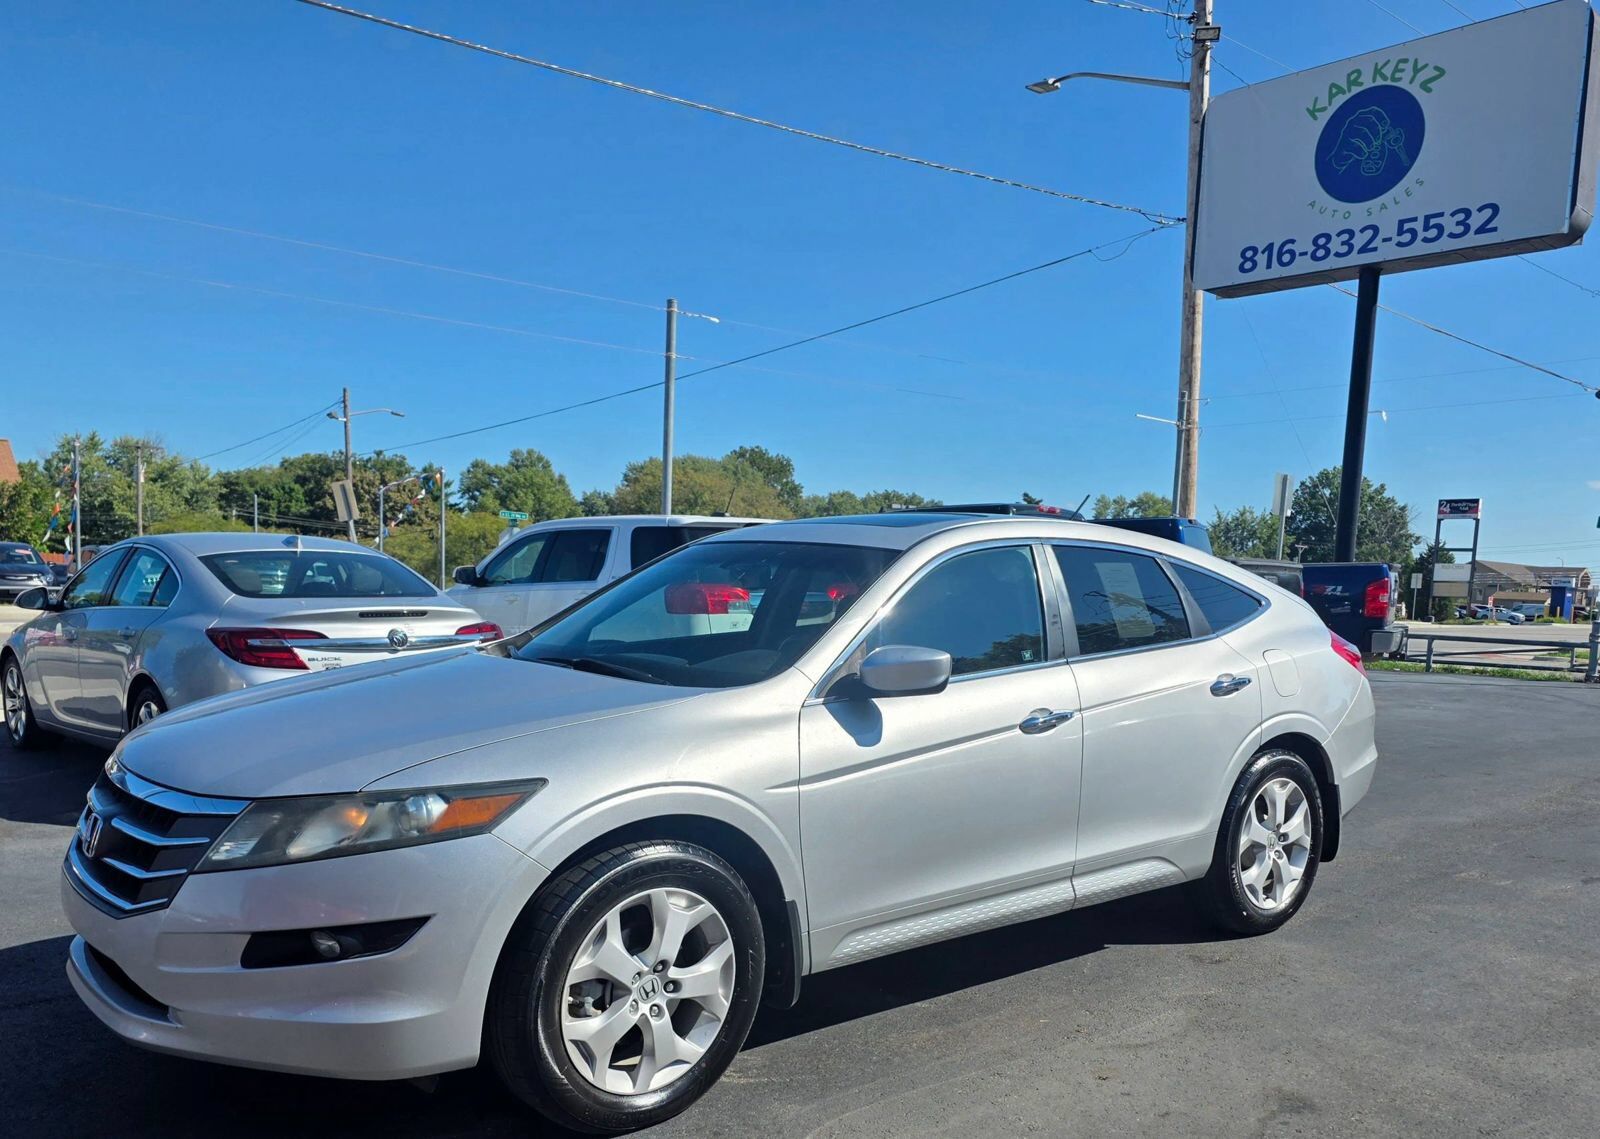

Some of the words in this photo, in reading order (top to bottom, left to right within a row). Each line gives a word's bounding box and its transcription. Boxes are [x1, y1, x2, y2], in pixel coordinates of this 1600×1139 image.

[1306, 68, 1364, 121] KAR
[1372, 58, 1446, 93] KEYZ
[1307, 199, 1351, 220] AUTO
[1366, 178, 1425, 217] SALES
[1238, 202, 1501, 274] 816-832-5532
